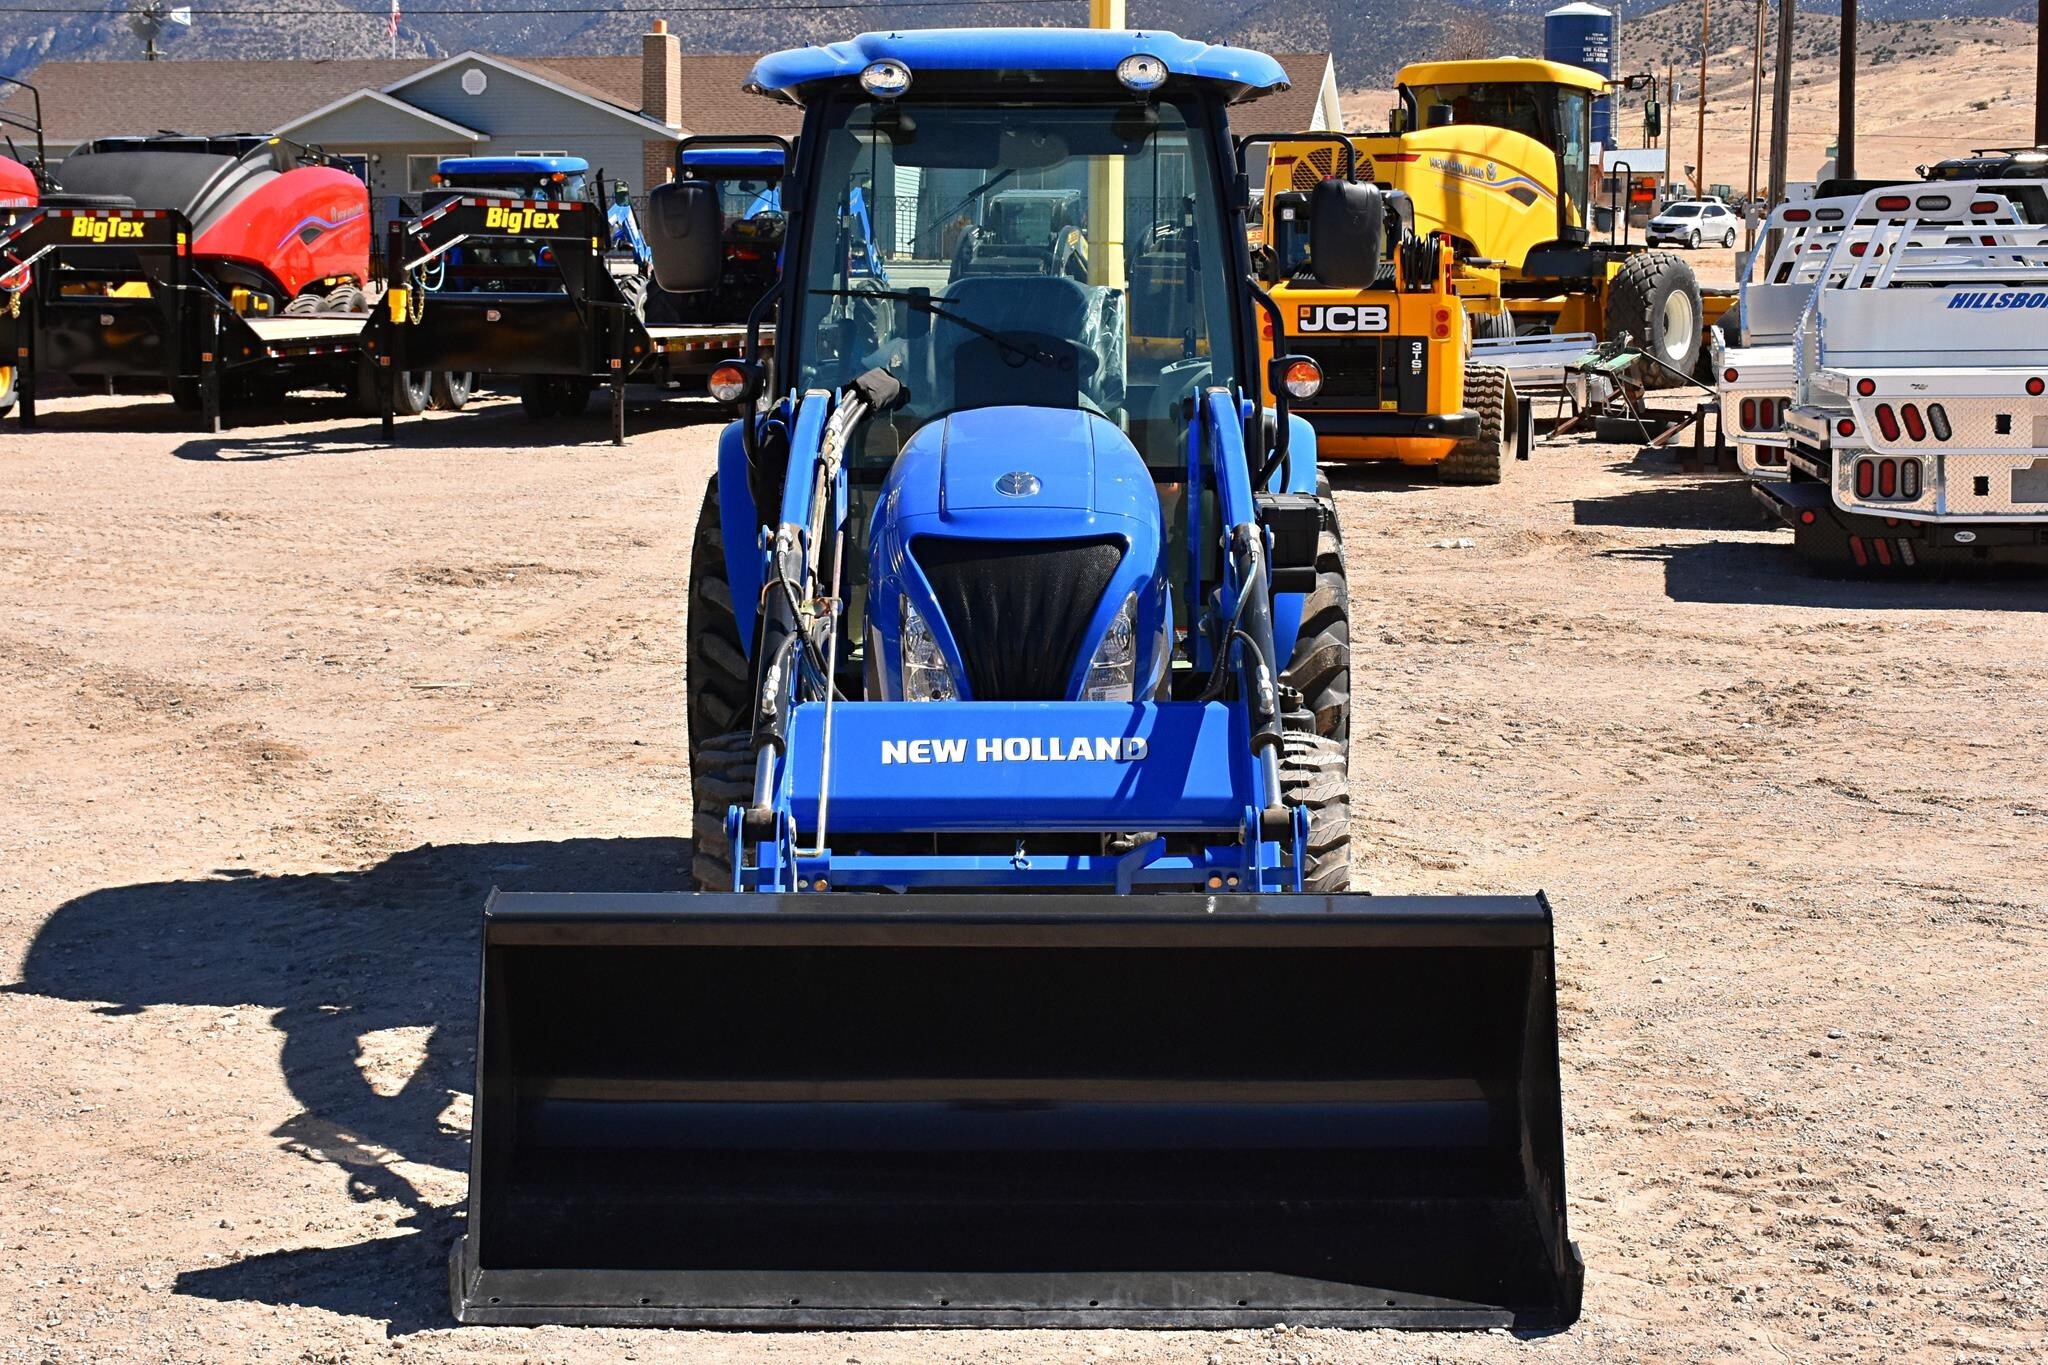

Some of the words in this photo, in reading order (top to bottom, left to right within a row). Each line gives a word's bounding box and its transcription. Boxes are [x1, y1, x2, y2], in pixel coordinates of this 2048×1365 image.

[71, 216, 145, 243] BigTex
[485, 207, 560, 234] BigTex
[1300, 306, 1388, 331] JCB
[1411, 342, 1422, 369] 3TS
[881, 738, 968, 765] NEW
[976, 736, 1149, 763] HOLLAND
